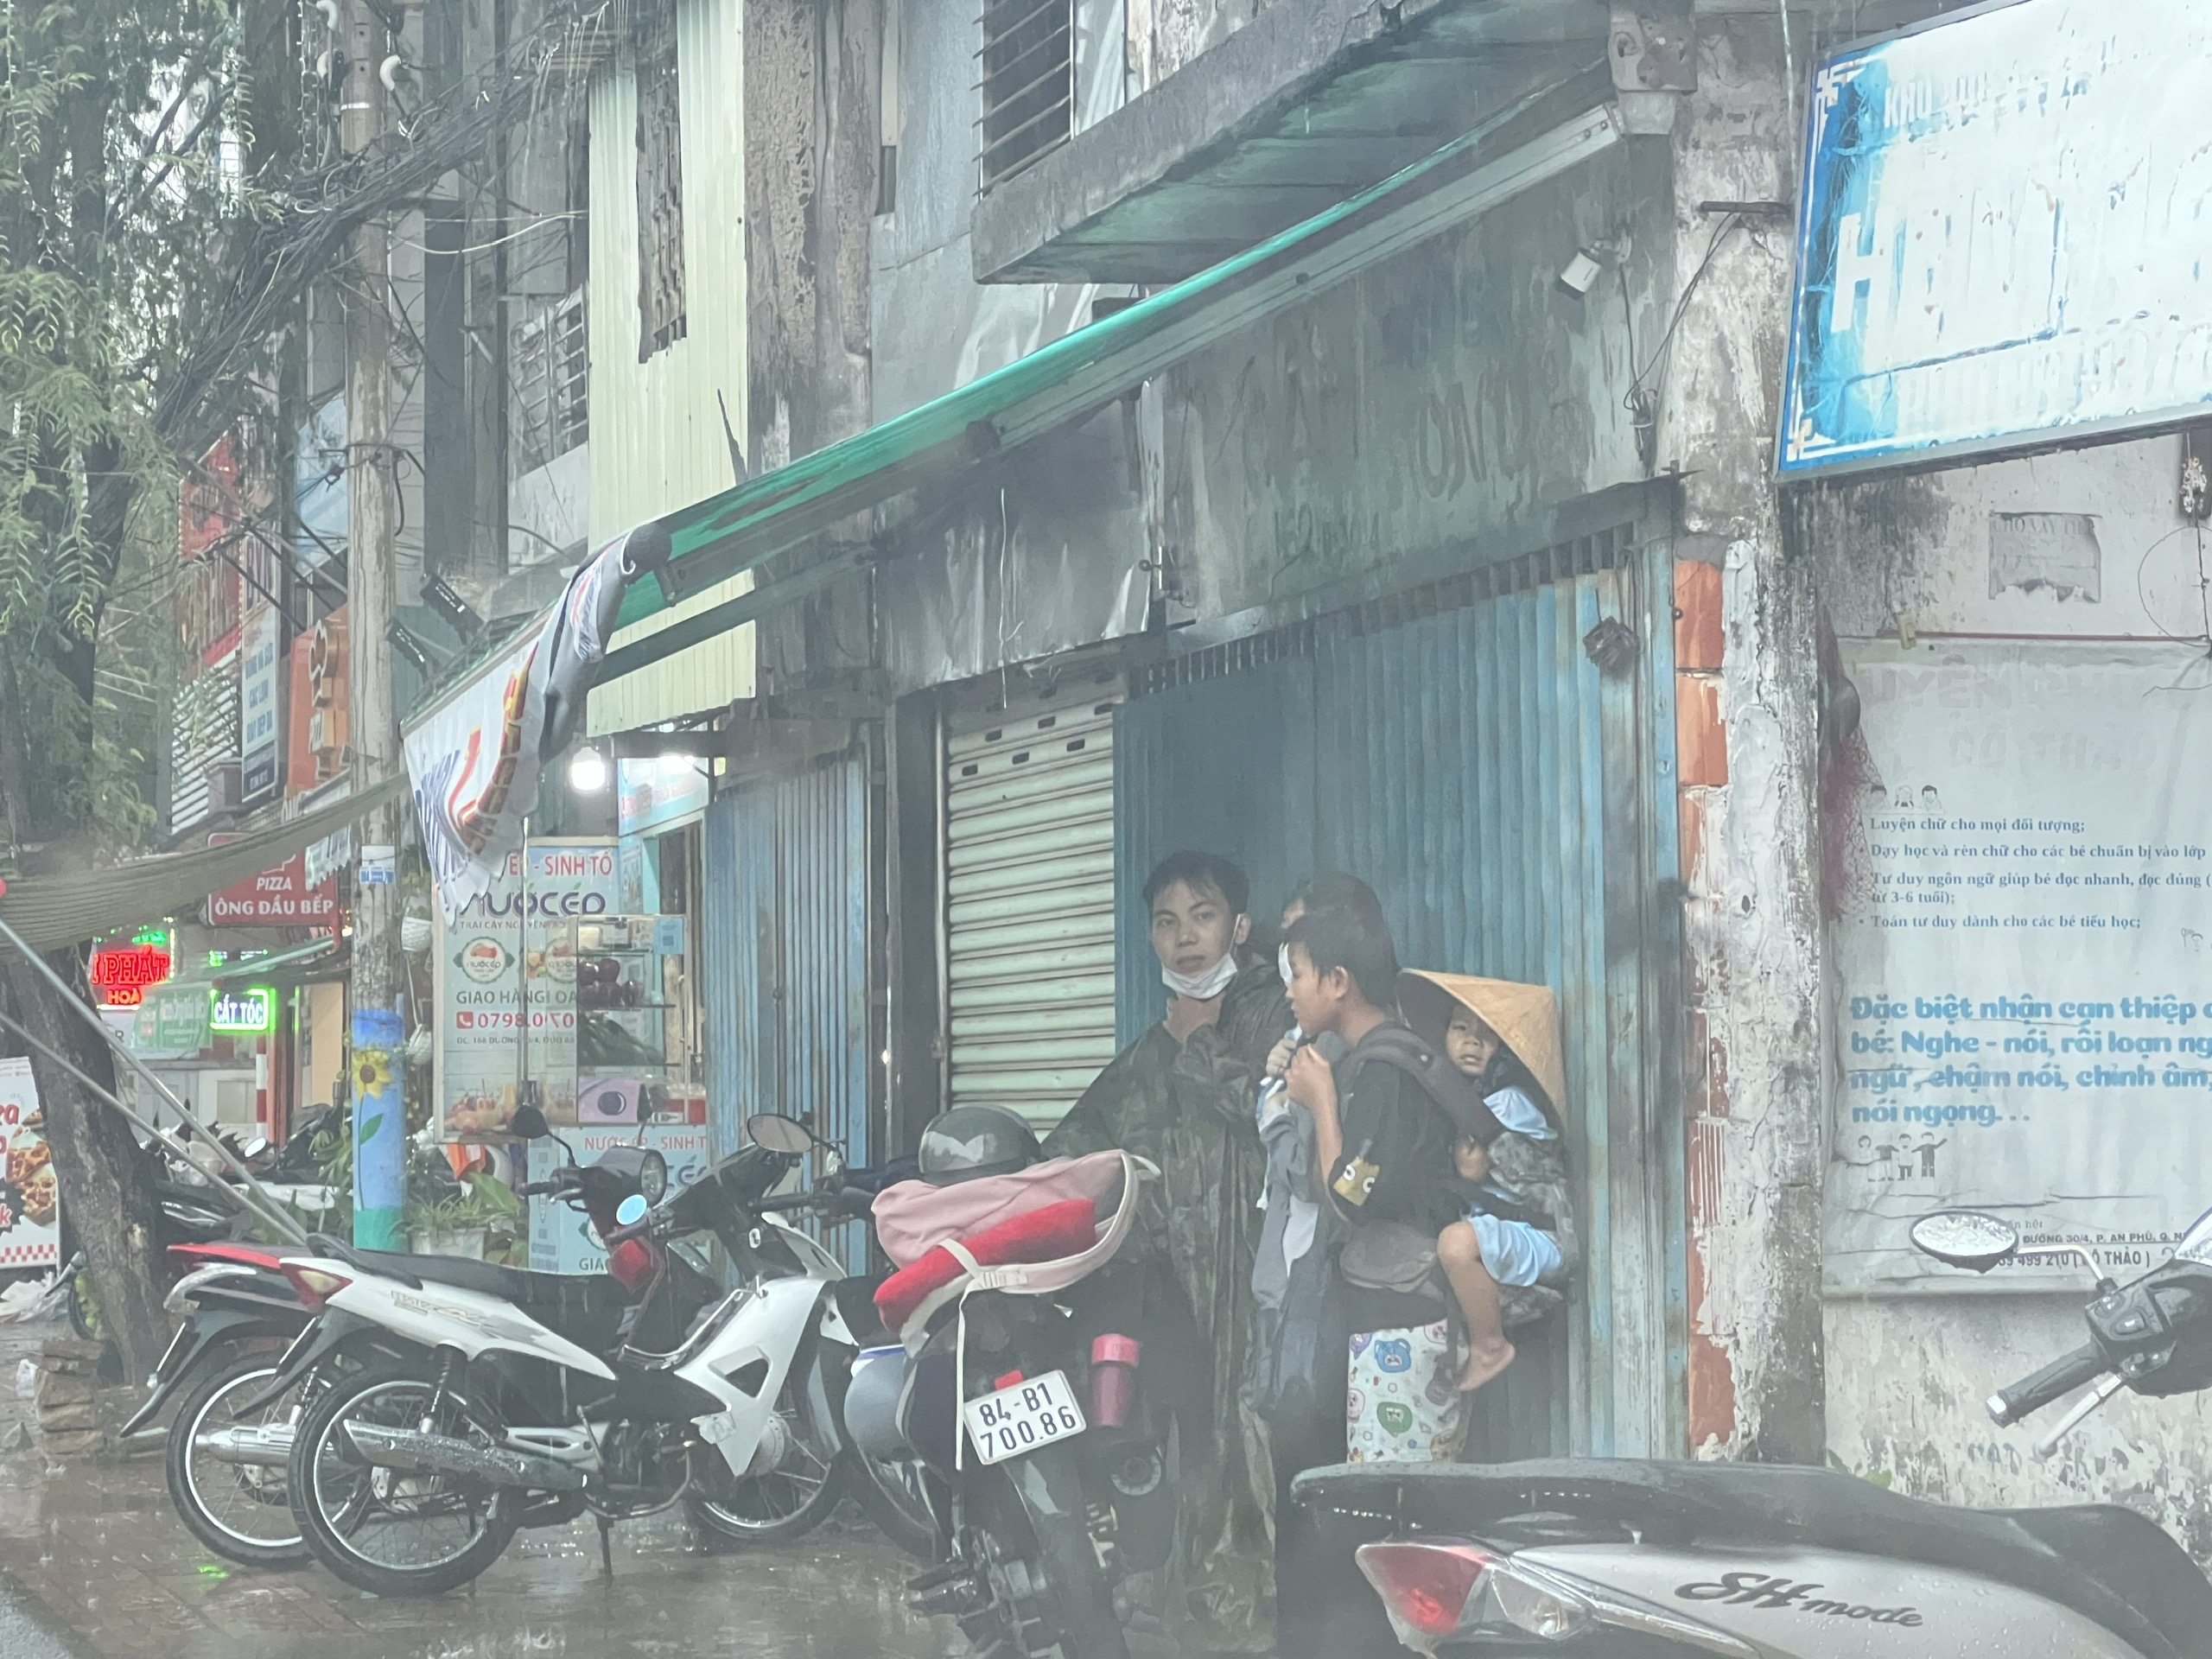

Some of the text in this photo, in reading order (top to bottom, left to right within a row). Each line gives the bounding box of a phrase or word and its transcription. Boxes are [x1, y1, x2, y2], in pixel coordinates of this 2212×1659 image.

[1871, 817, 2084, 834] Luyện chữ cho mọi đối tượng;
[1871, 844, 1898, 858] Dạy
[1904, 844, 1929, 859] học
[1932, 845, 1948, 856] và
[1954, 845, 1977, 856] rèn
[1982, 844, 2009, 856] chữ
[2013, 845, 2037, 856] cho
[2042, 845, 2065, 856] các
[2070, 845, 2086, 856] bé
[2139, 845, 2152, 860] bị
[2155, 846, 2178, 857] vào
[2183, 845, 2206, 860] lớp
[544, 855, 585, 876] SINH
[589, 848, 613, 876] TỐ
[257, 877, 292, 891] PIZZA
[1897, 873, 1923, 887] duy
[1928, 873, 1961, 887] ngôn
[1967, 873, 1994, 887] ngữ
[1999, 873, 2030, 887] giúp
[2034, 873, 2050, 885] bé
[2055, 873, 2080, 887] đọc
[2084, 873, 2133, 887] nhanh,
[2139, 873, 2161, 887] đọc
[2165, 873, 2202, 888] đúng
[215, 893, 334, 915] ÔNG ĐẦU BẾP
[1891, 892, 1913, 903] 3-6
[1871, 915, 1907, 927] Toán
[1913, 916, 1930, 927] tư
[1932, 915, 1957, 930] duy
[1962, 915, 1999, 927] dành
[2004, 915, 2027, 927] cho
[2032, 915, 2055, 927] các
[2060, 916, 2075, 927] bé
[2111, 916, 2140, 930] học;
[104, 945, 168, 984] PHÁT
[456, 990, 495, 1004] GIAO
[1849, 994, 1909, 1026] Đặc
[1915, 994, 1973, 1025] biệt
[1980, 994, 2052, 1026] nhận
[2058, 1002, 2113, 1019] can
[2120, 995, 2196, 1026] thiệp
[1902, 1031, 1980, 1058] Nghe
[2004, 1028, 2055, 1058] nói,
[2061, 1020, 2102, 1053] rối
[2108, 1031, 2171, 1058] loạn
[2017, 1063, 2069, 1091] nói,
[1853, 1097, 1897, 1122] nói
[661, 1136, 694, 1149] SINH
[2110, 1234, 2126, 1243] AN
[579, 1257, 607, 1271] GIA
[979, 1382, 1052, 1427] 84-B1
[1675, 1572, 1923, 1627] SH mode
